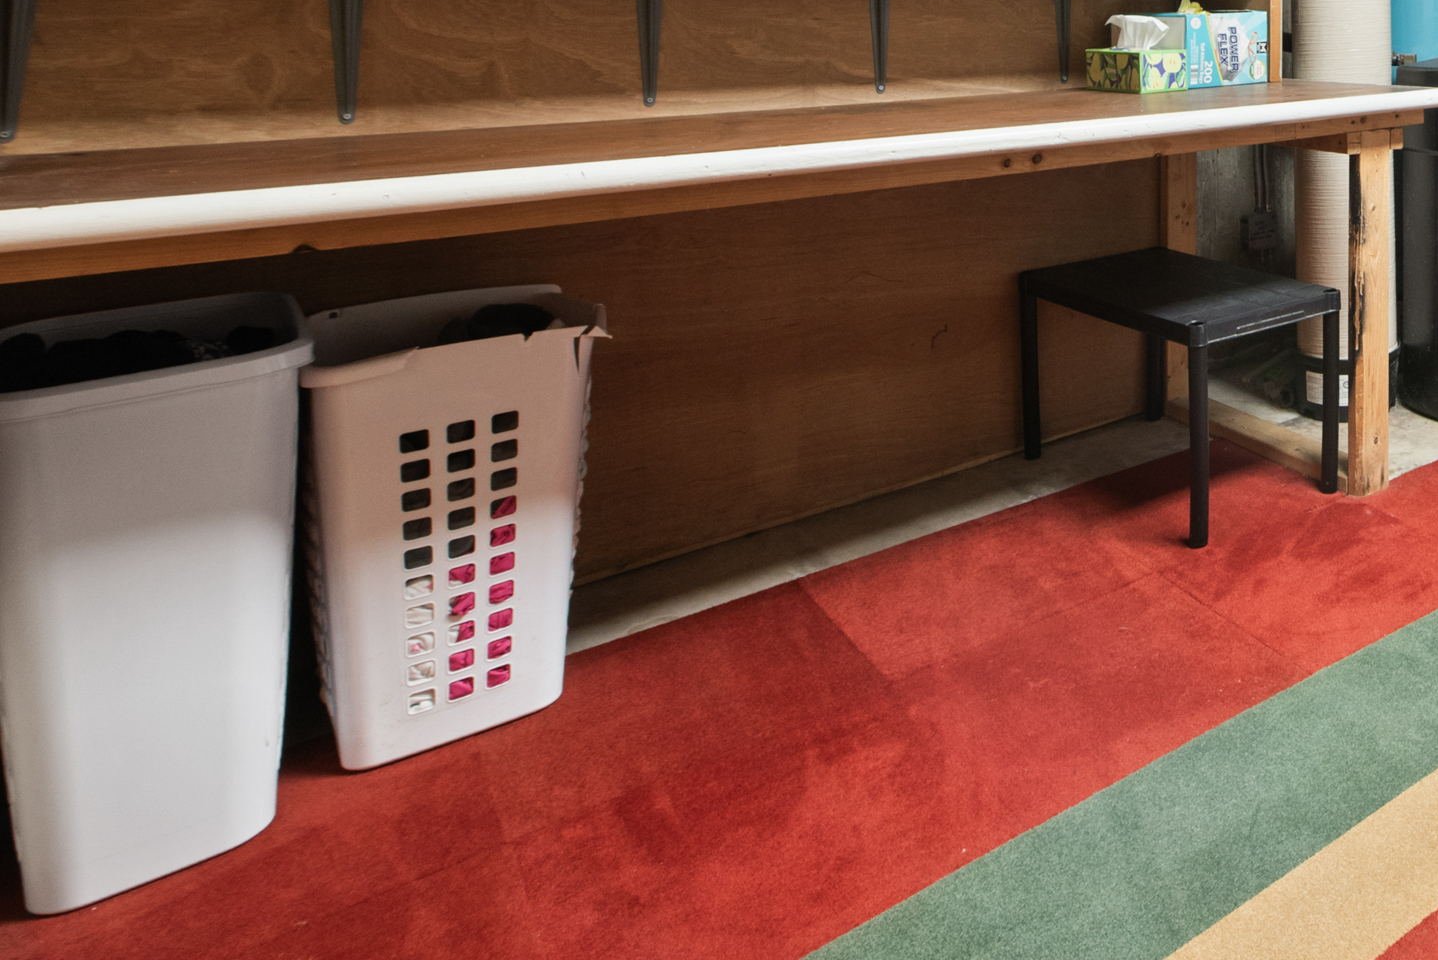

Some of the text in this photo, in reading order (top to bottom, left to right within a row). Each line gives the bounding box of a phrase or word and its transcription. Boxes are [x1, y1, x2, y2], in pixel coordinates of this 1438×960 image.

[1219, 33, 1228, 65] FLEX
[1228, 26, 1239, 72] POWER
[1203, 60, 1213, 84] 200
